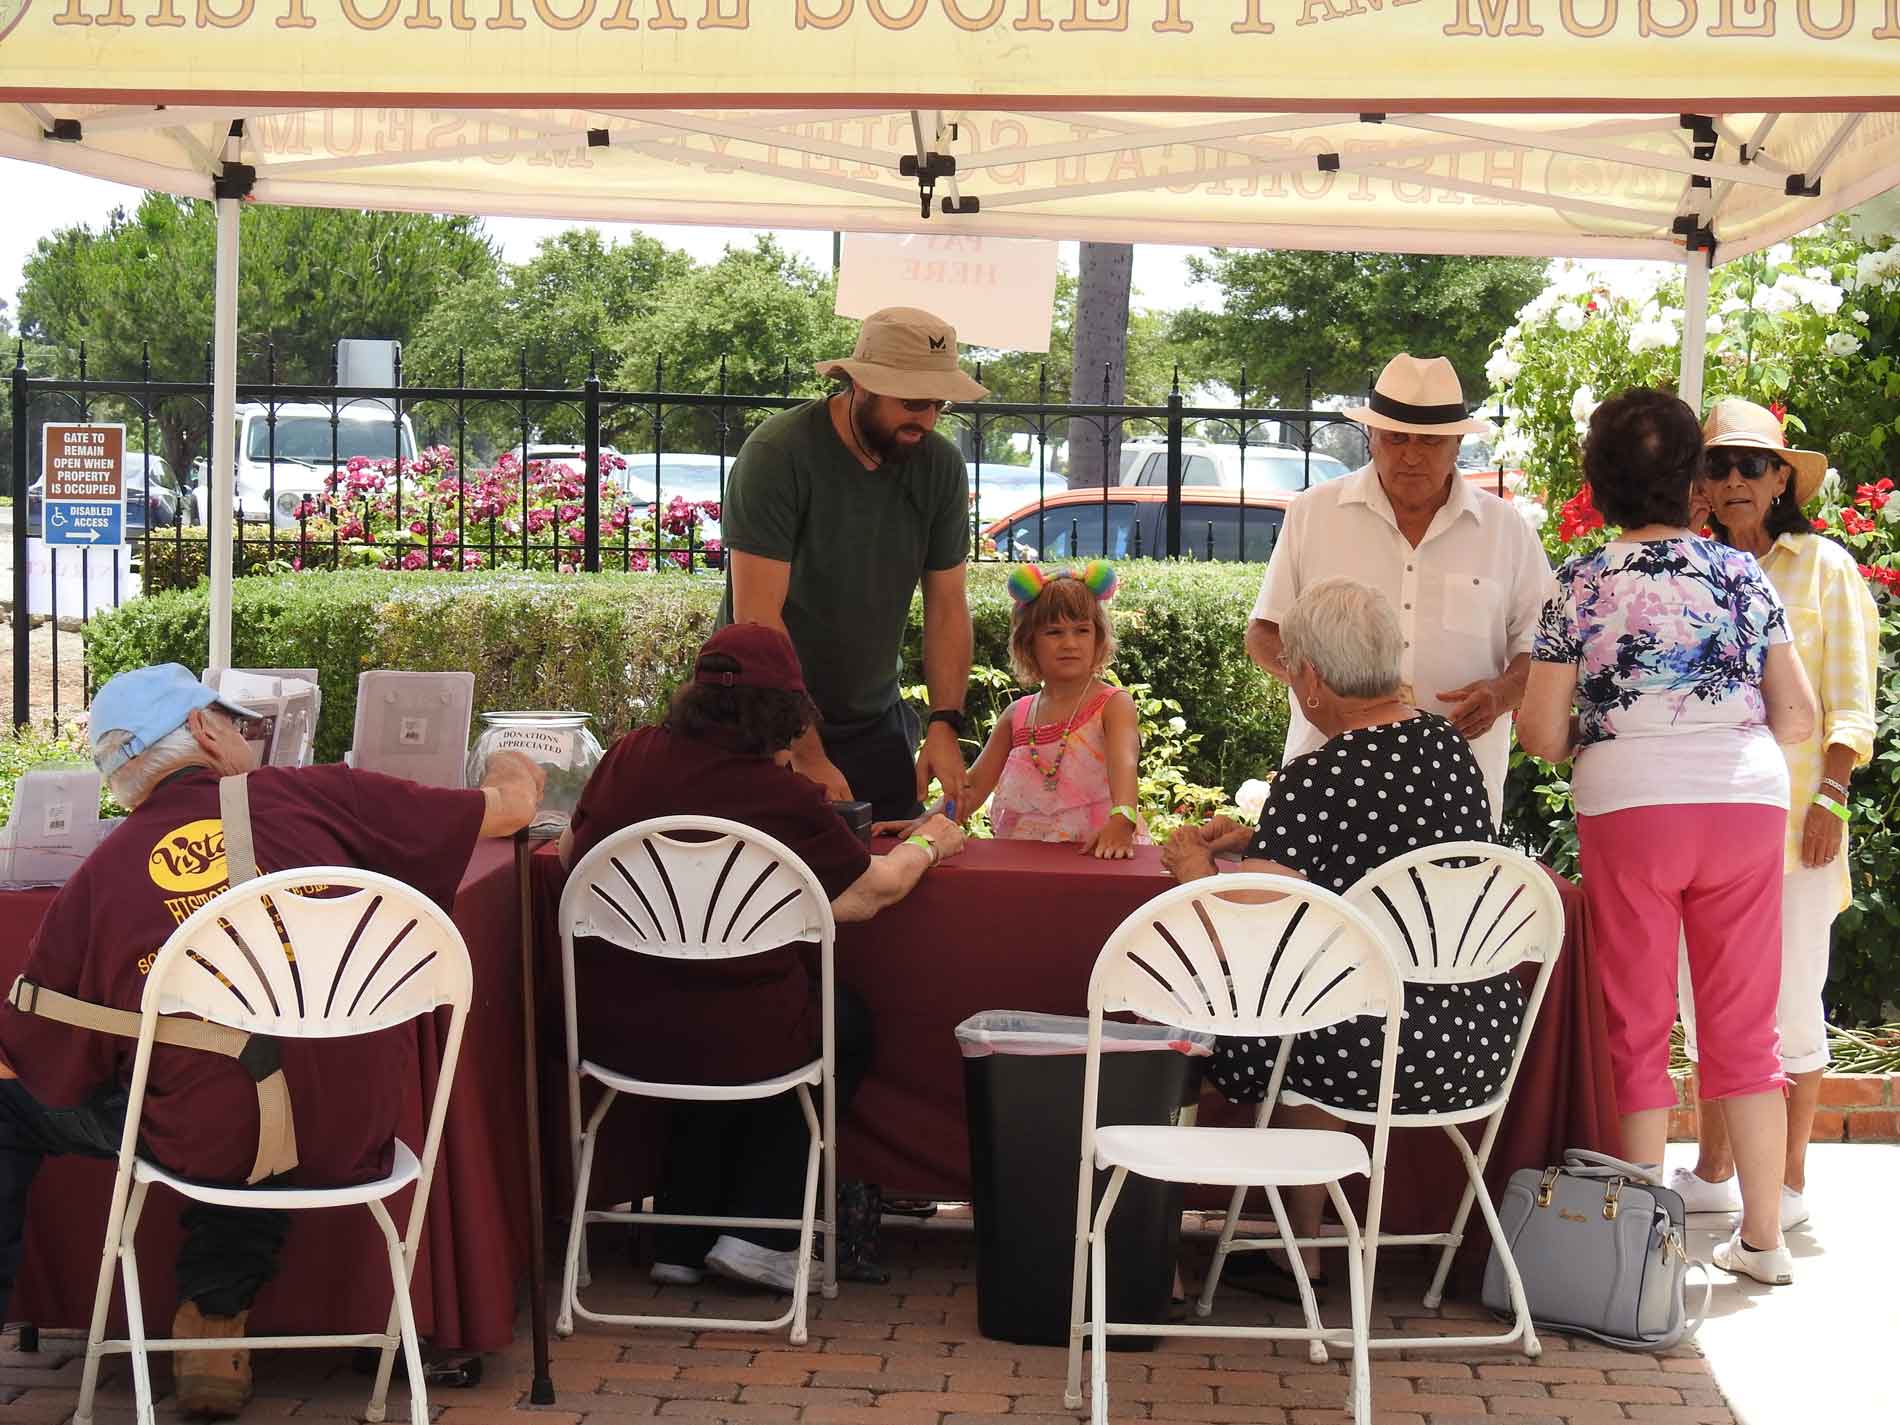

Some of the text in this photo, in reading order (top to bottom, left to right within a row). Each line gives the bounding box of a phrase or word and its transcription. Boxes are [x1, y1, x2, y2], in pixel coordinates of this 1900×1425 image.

[63, 432, 105, 444] GATE TO
[64, 445, 104, 456] REMAIN
[53, 458, 114, 470] OPEN WHEN
[57, 471, 111, 482] PROPERTY
[51, 484, 116, 495] IS OCCUPIED
[70, 506, 113, 516] DISABLED
[74, 518, 109, 528] ACCESS
[503, 730, 560, 744] DONATIONS
[497, 741, 562, 754] APPRECIATED
